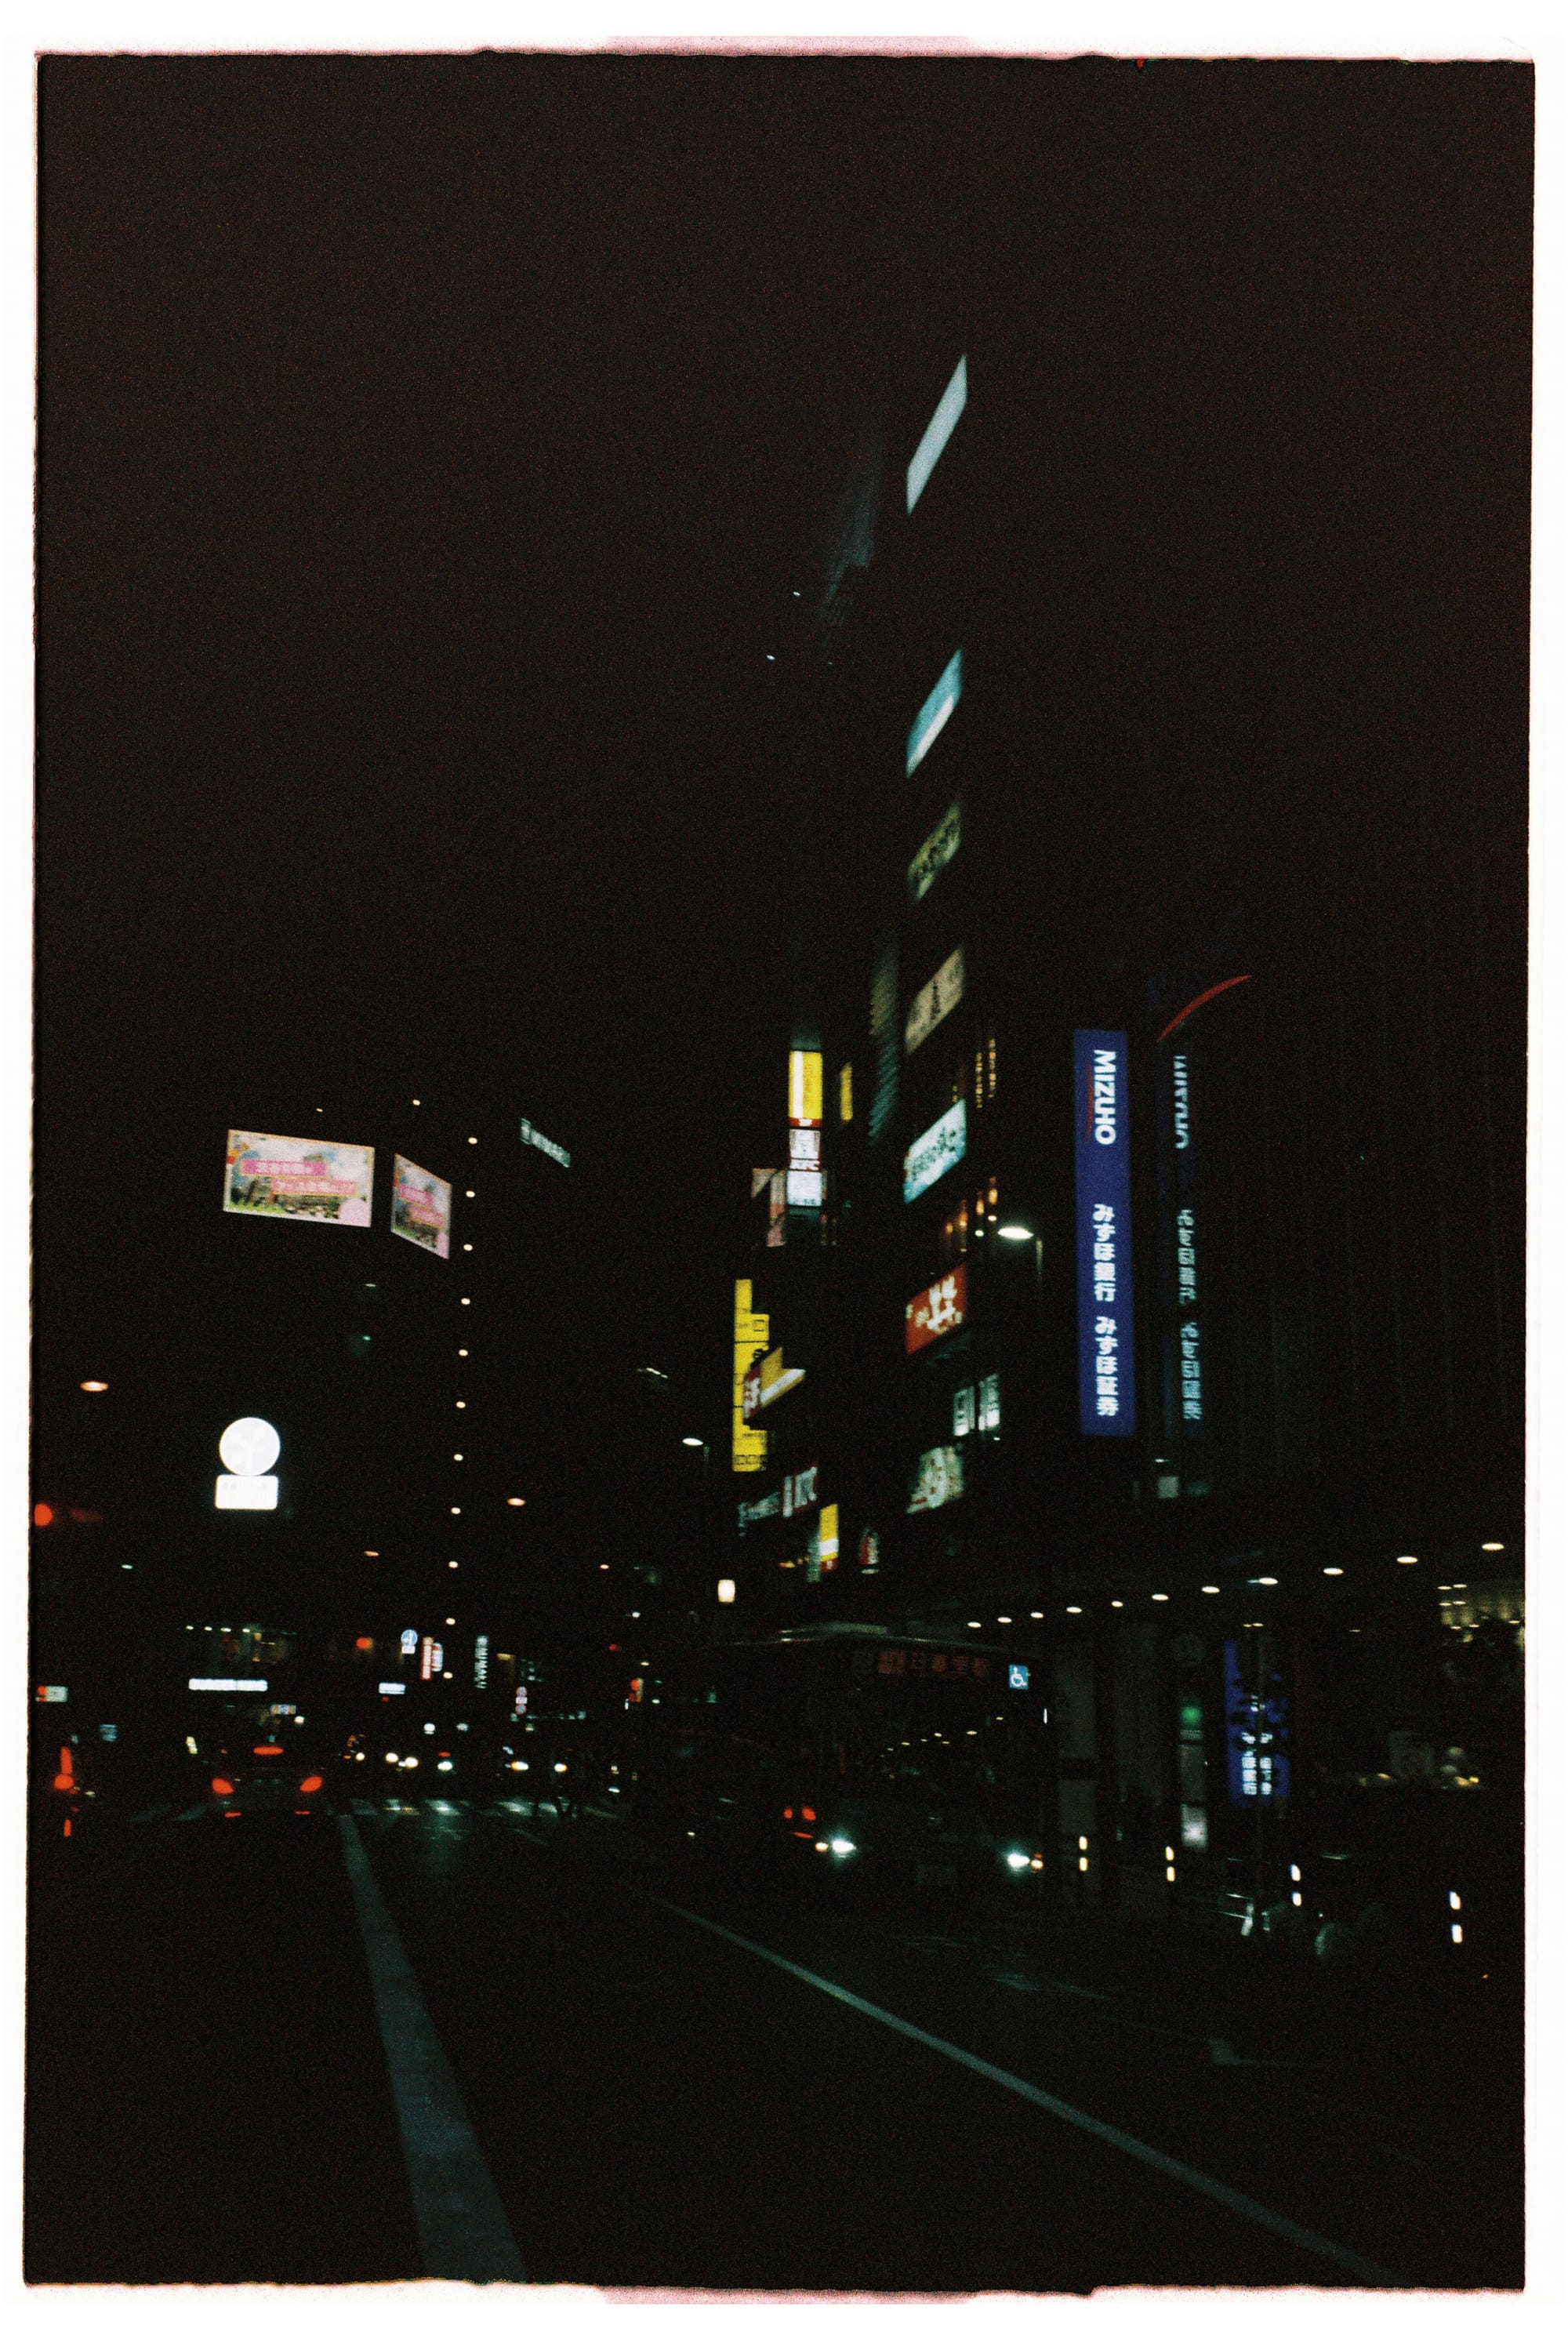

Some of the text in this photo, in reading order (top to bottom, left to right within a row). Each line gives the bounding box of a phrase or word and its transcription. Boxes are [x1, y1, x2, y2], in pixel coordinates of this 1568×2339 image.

[1094, 1049, 1116, 1145] MIZUHO
[1093, 1204, 1120, 1416] みずほ銀行 みずほ証券
